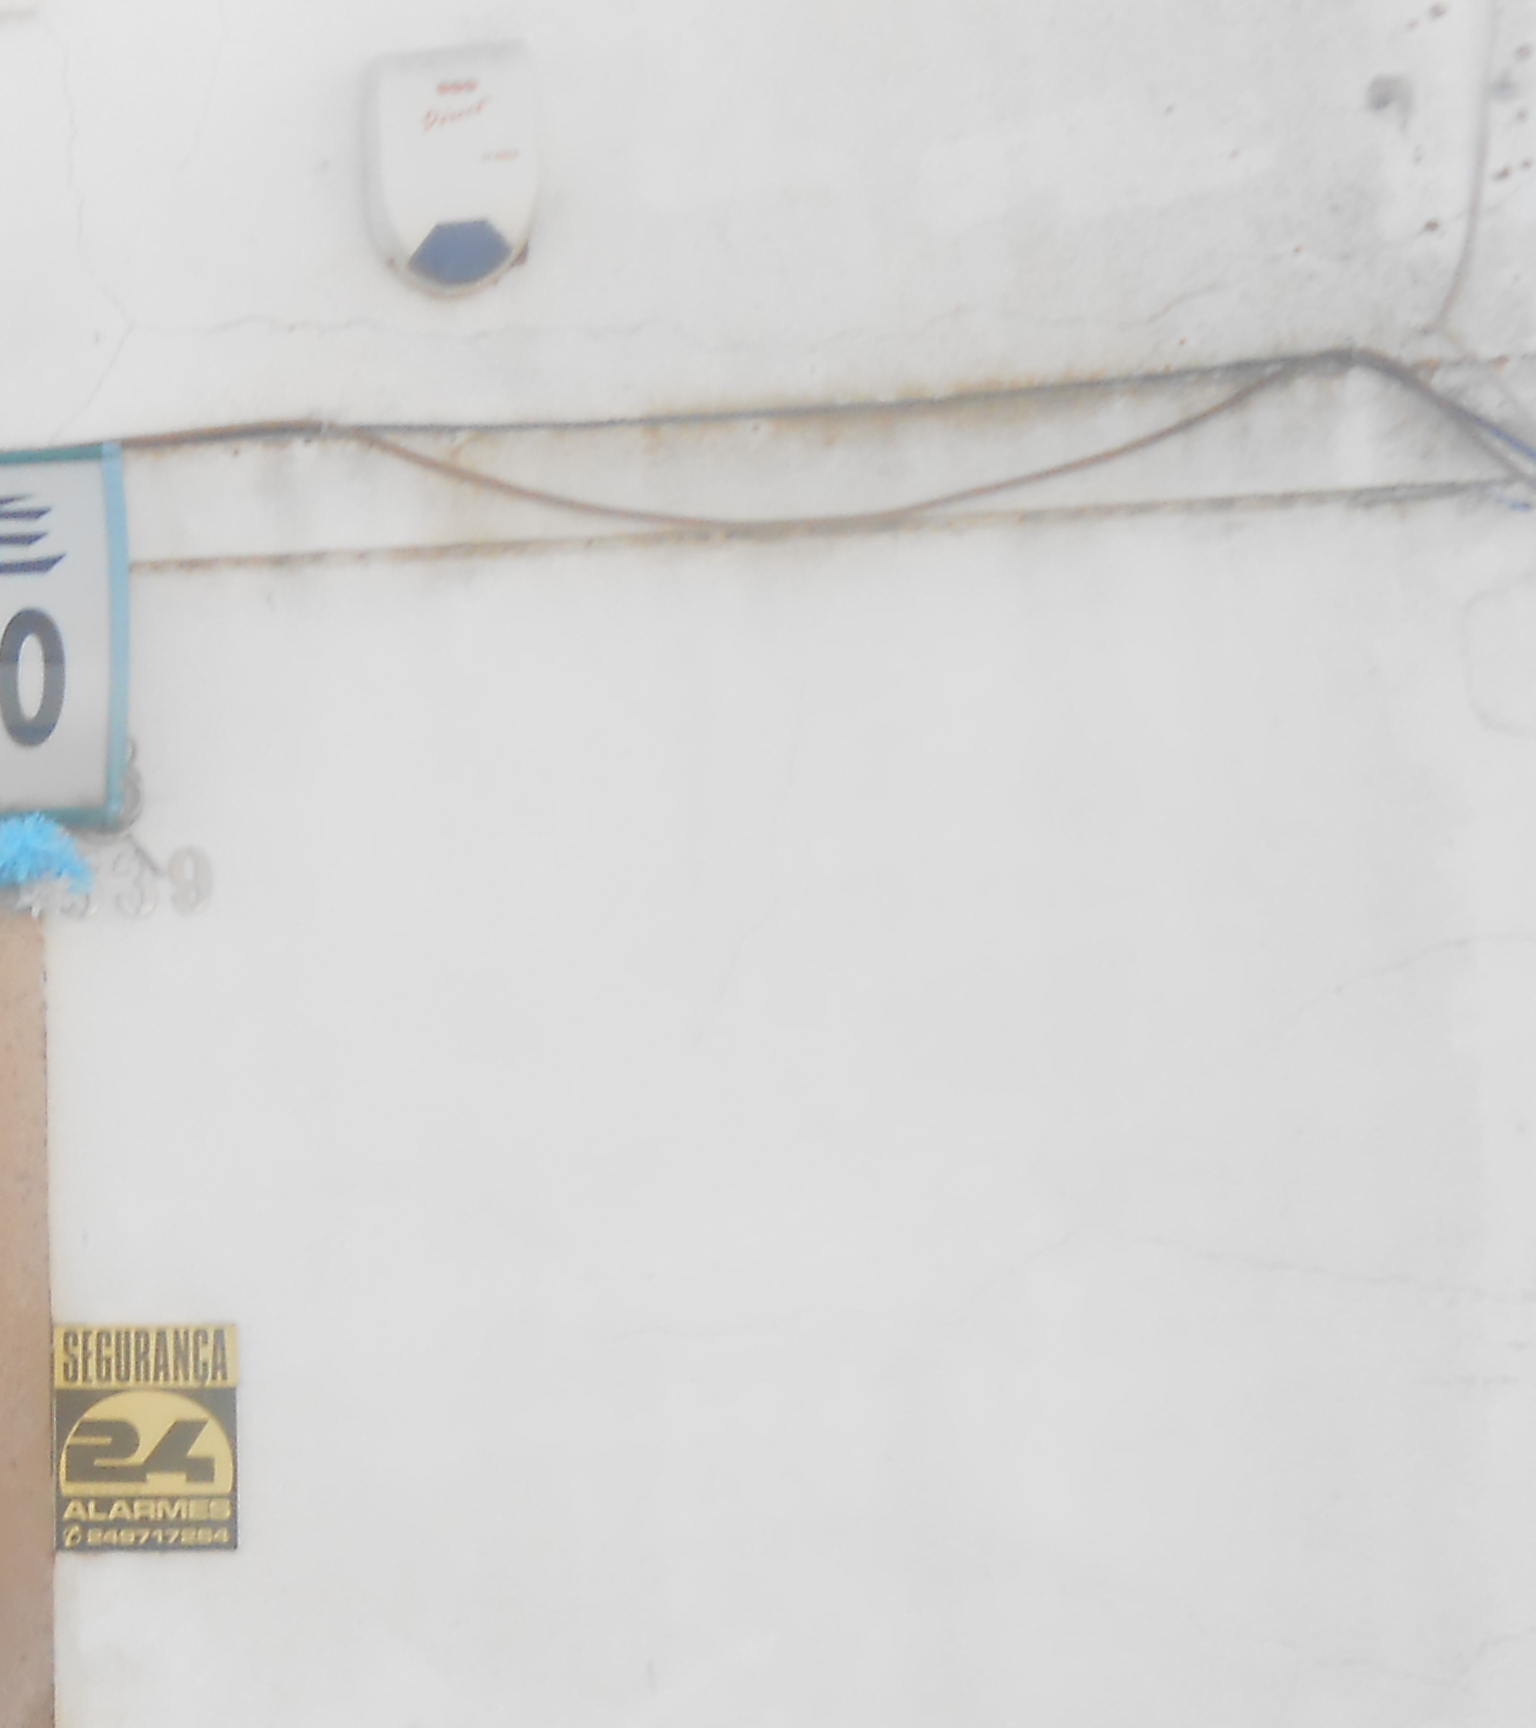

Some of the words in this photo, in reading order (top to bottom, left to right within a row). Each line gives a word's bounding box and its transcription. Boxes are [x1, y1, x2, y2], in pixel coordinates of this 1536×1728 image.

[63, 1328, 228, 1386] SEGURANÇA
[65, 1419, 215, 1483] 24
[63, 1499, 232, 1521] ALARMES
